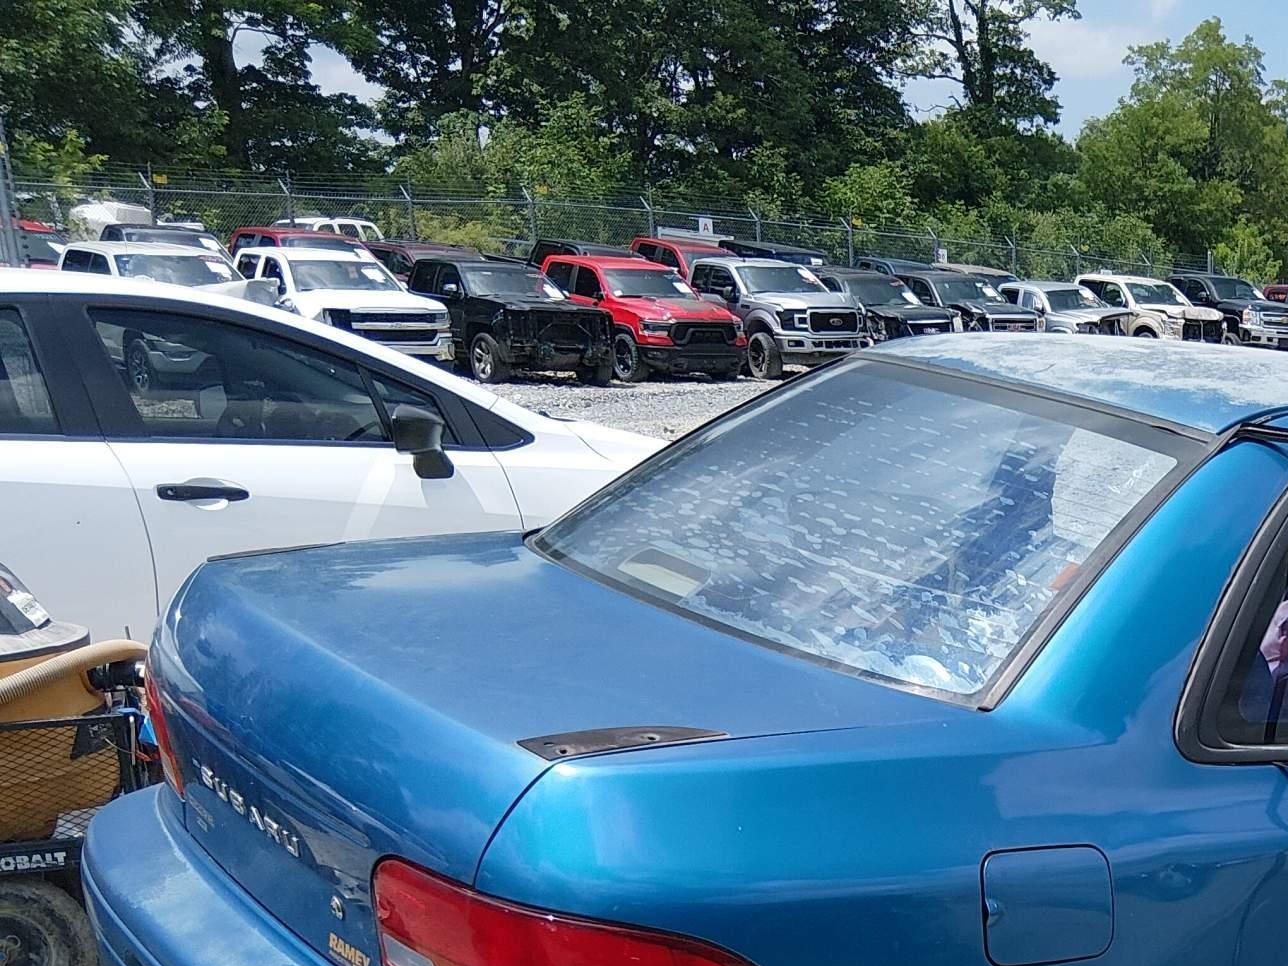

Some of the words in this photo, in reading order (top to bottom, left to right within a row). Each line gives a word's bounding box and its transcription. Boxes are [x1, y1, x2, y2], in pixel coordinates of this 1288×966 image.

[702, 222, 711, 233] A
[201, 766, 300, 857] SUBARU
[0, 851, 67, 872] OBALT
